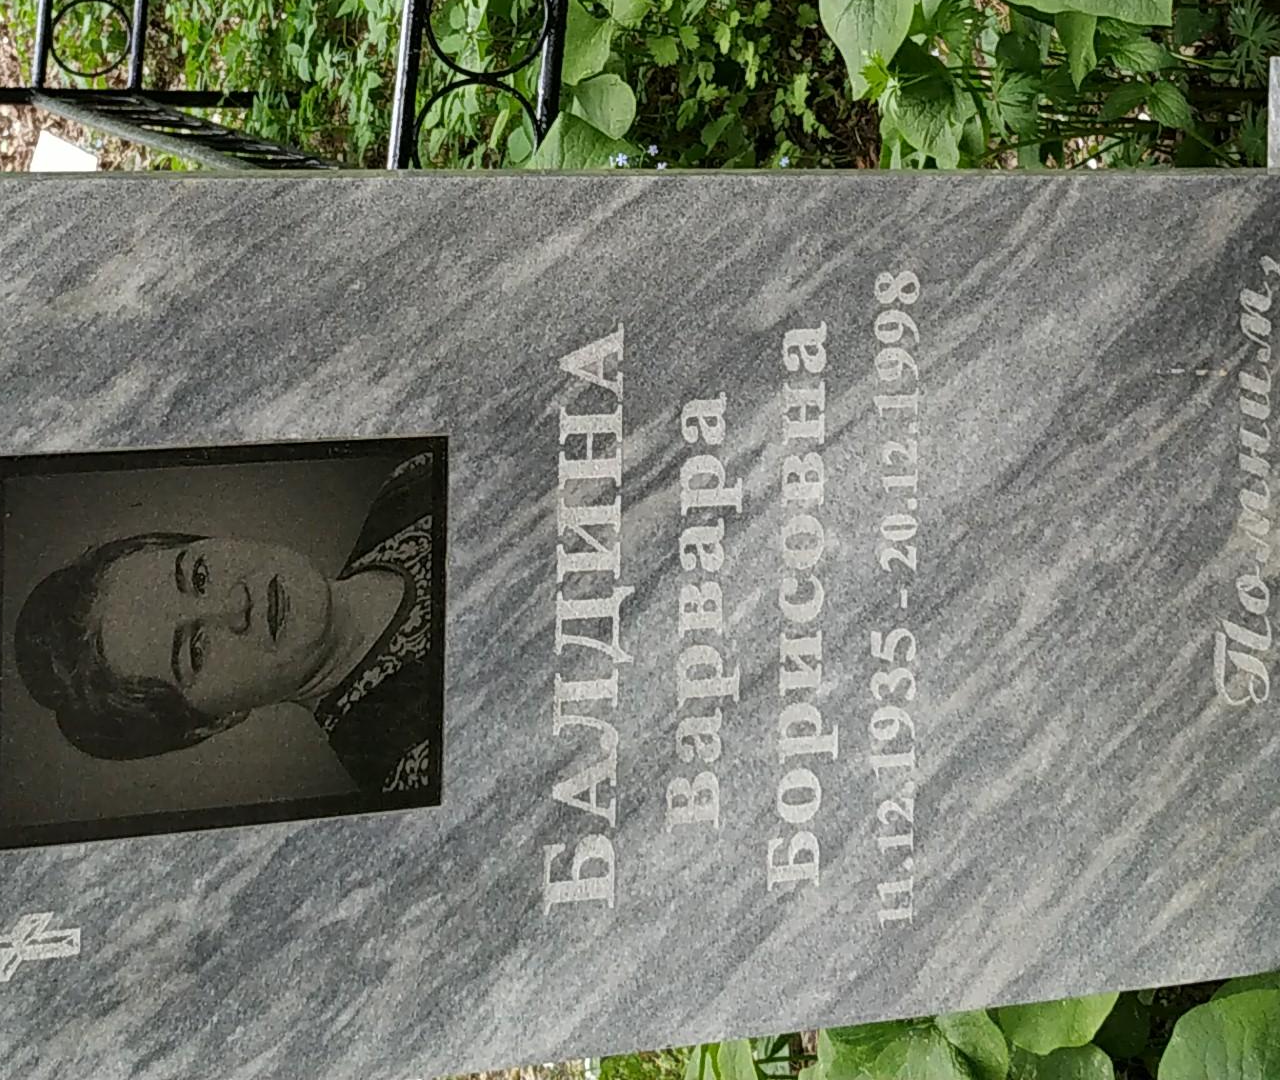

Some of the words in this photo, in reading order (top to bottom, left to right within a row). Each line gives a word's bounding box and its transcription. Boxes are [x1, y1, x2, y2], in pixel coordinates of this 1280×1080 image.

[544, 322, 635, 917] БАЛДИНА
[666, 392, 743, 834] Варвара
[766, 320, 838, 893] Борисовна
[873, 269, 922, 575] 20.12.1998
[868, 625, 918, 926] 11.12.1935
